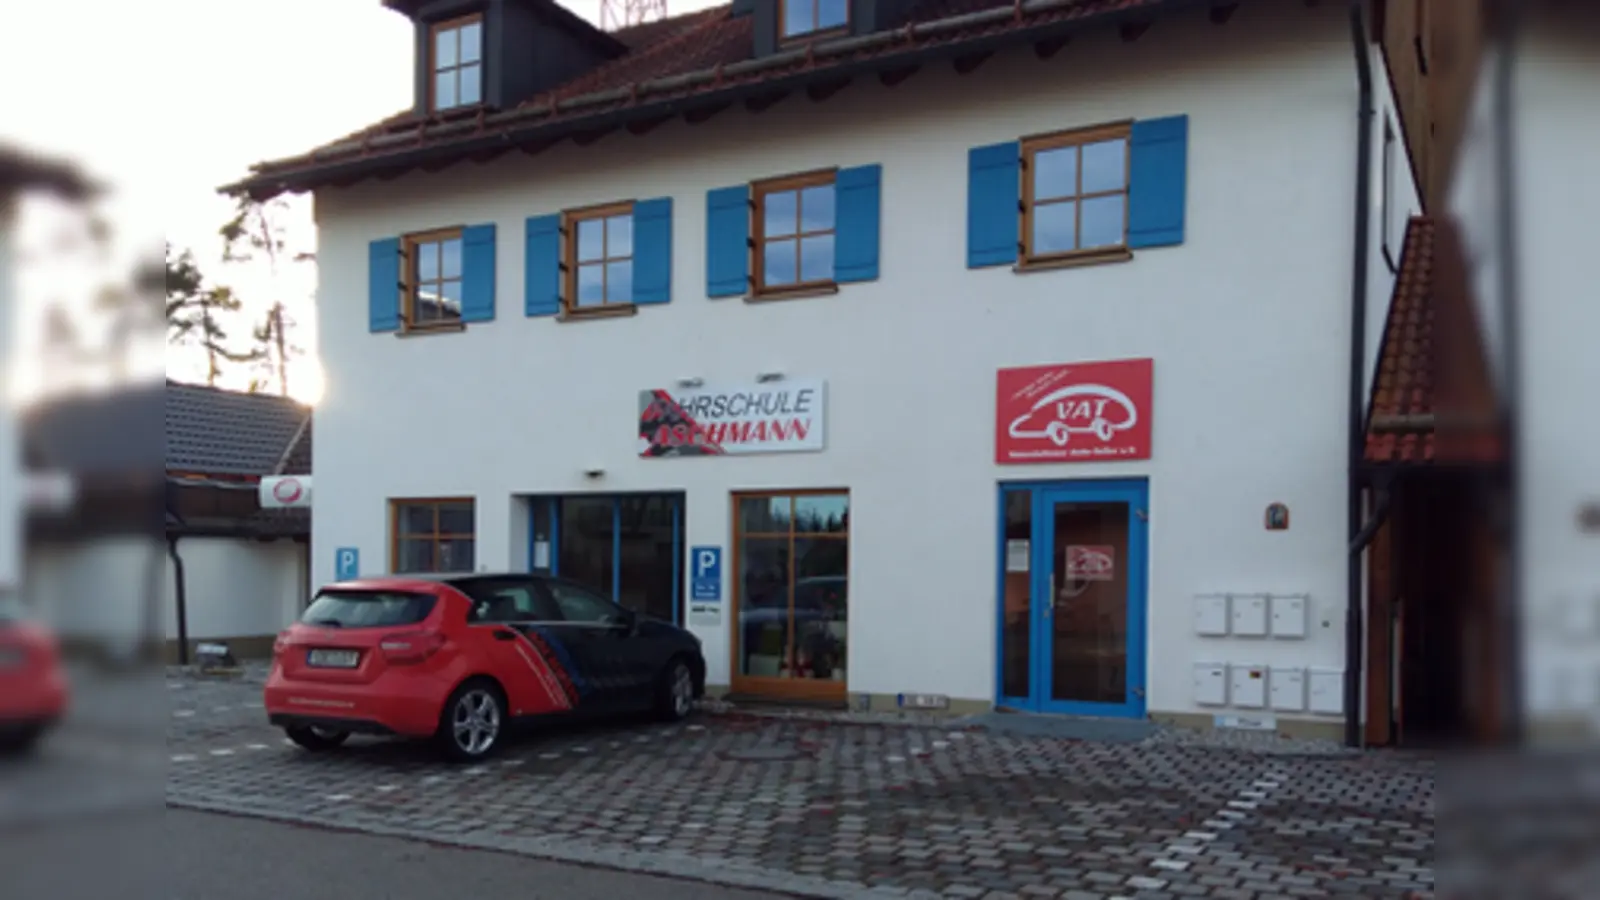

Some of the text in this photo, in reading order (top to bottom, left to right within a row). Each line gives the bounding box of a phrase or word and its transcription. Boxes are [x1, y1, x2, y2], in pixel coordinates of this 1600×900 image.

[646, 388, 813, 420] HRSCHULE
[342, 551, 354, 576] P
[698, 550, 715, 578] P
